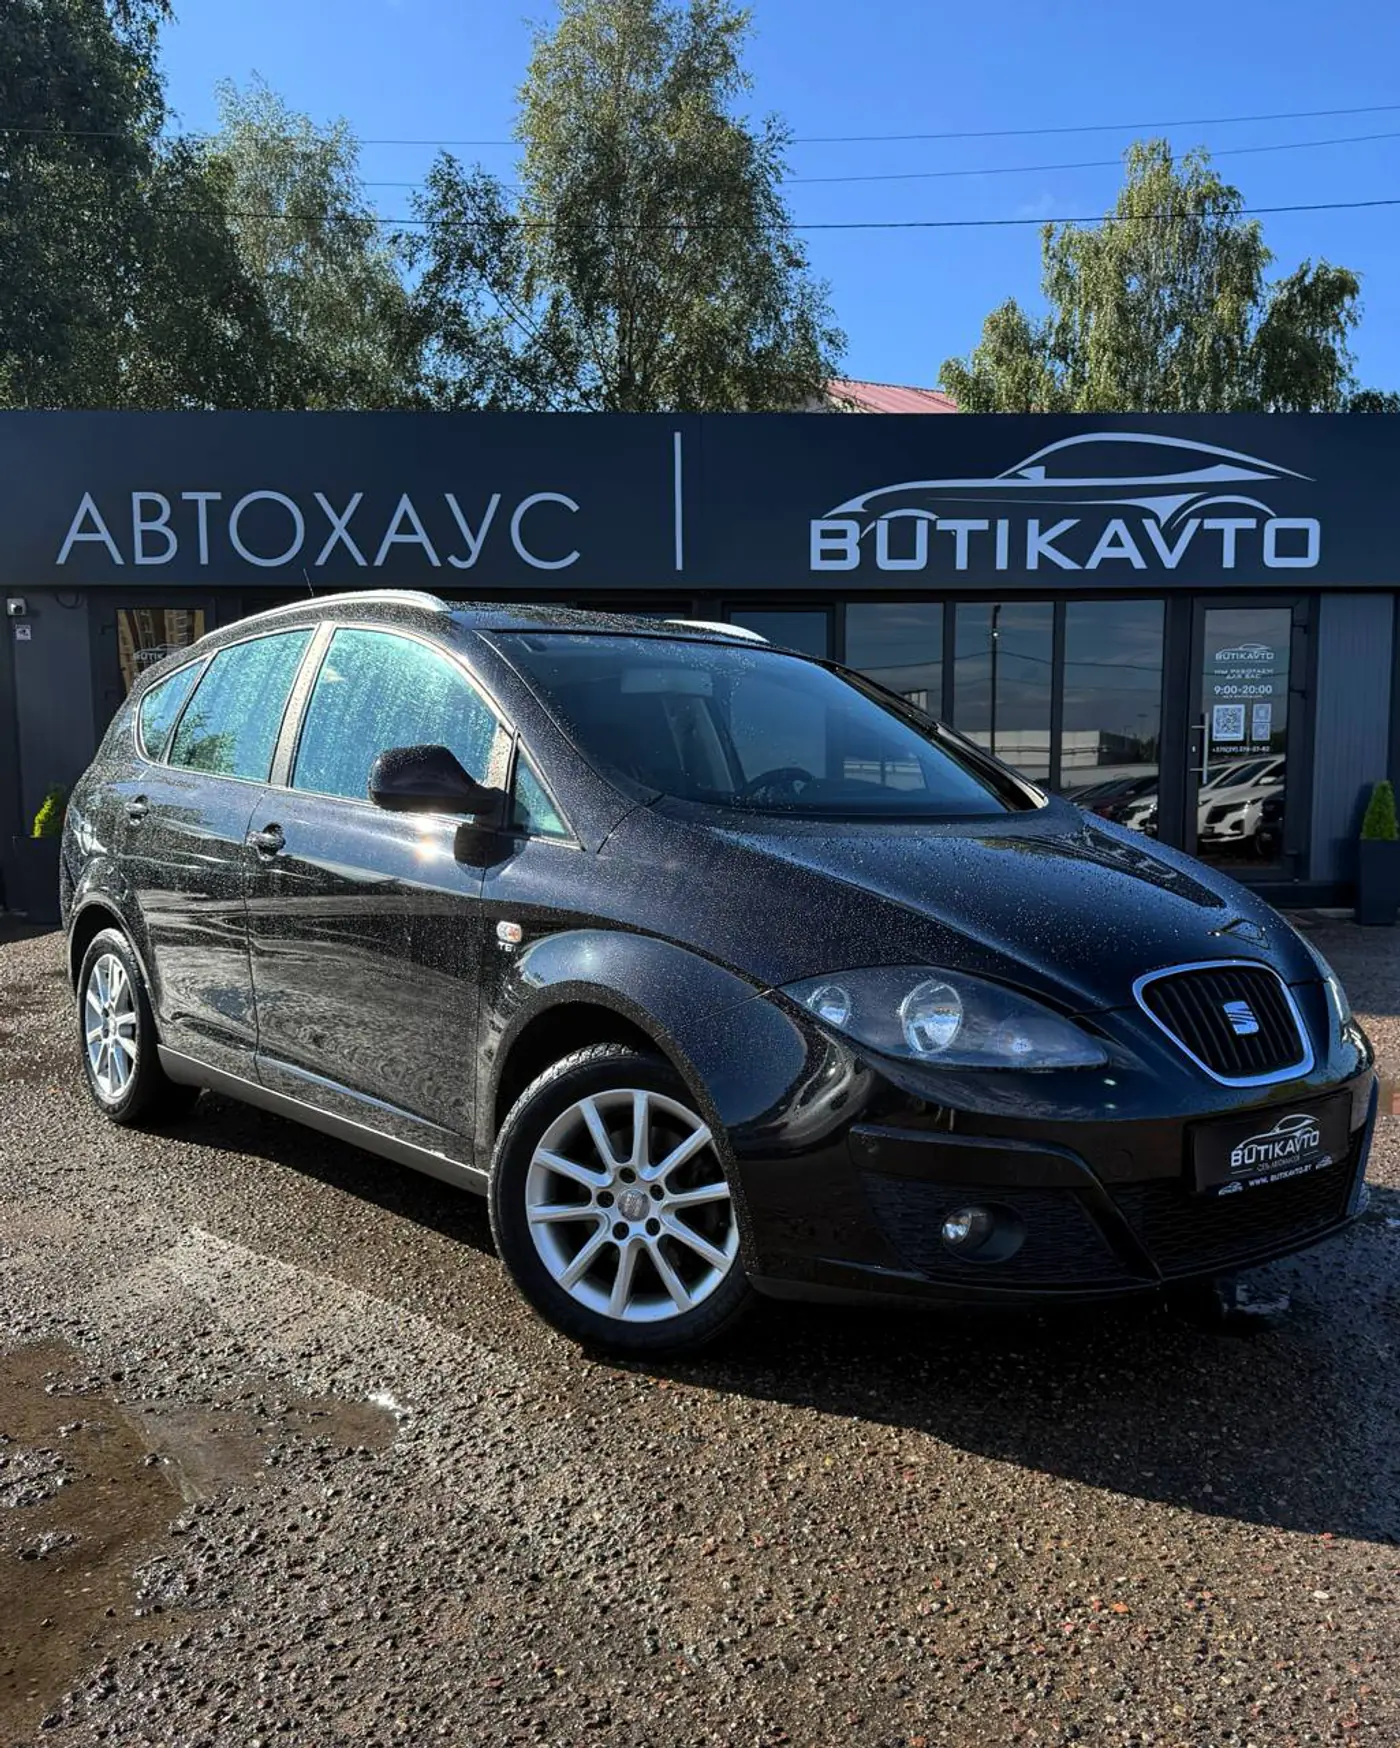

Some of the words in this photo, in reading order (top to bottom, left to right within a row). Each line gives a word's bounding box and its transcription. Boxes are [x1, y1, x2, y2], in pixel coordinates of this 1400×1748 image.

[56, 490, 581, 570] АВТОХАУС
[810, 517, 1321, 571] BUTIKAVTO
[1215, 652, 1274, 660] BUTIKAVTO
[1214, 685, 1273, 695] 9:00-20:00
[1230, 1131, 1320, 1167] BUTIKAVTO
